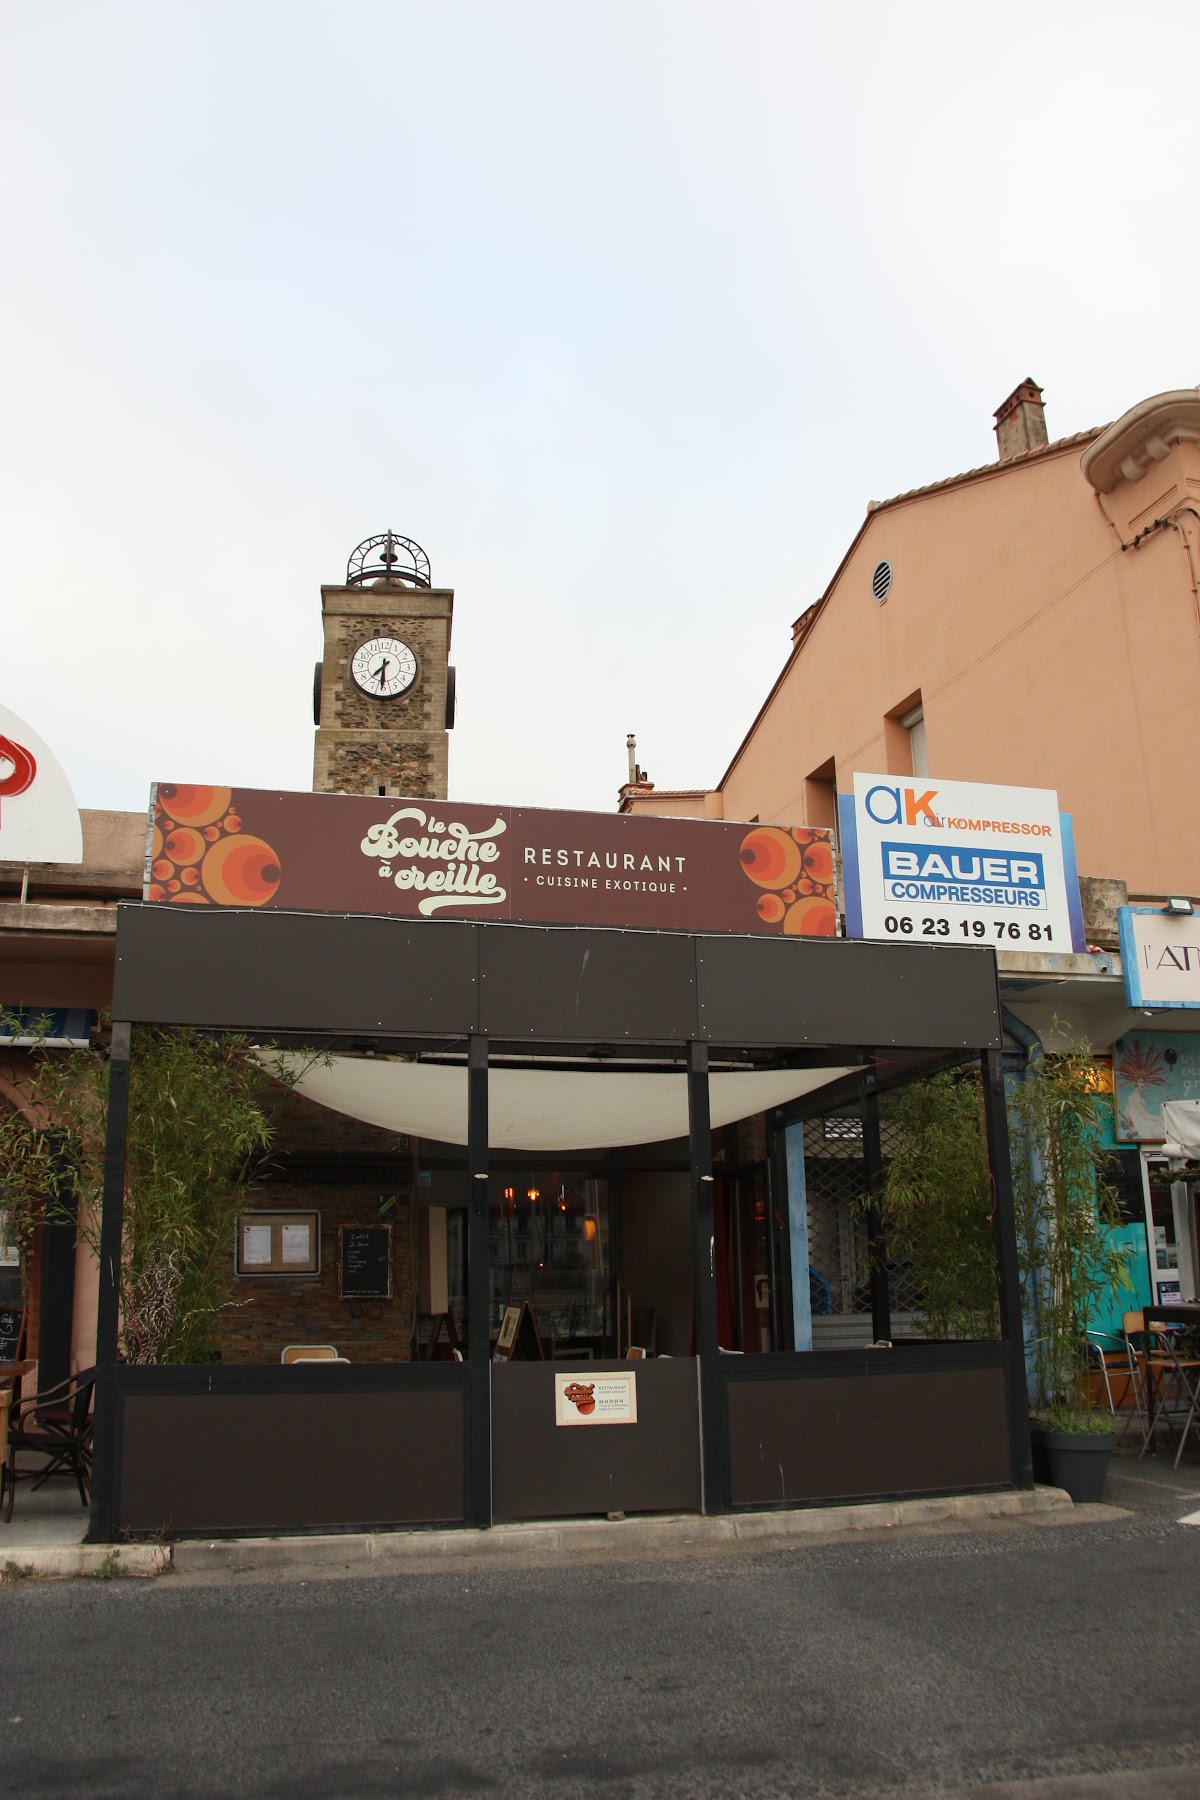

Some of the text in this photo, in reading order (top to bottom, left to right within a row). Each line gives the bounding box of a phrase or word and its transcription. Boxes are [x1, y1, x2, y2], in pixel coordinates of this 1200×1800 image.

[402, 652, 408, 660] 2
[360, 807, 507, 863] Bouche
[428, 816, 446, 834] le
[947, 816, 1052, 837] KOMPRESSOR
[524, 847, 687, 873] RESTAURANT
[888, 850, 1039, 885] BAUER
[394, 863, 507, 916] oreille
[536, 875, 677, 894] CUISINE EXOTIQUE
[891, 881, 1041, 907] COMPRESSEURS
[884, 915, 1054, 941] 06 23 19 76 81
[1143, 944, 1200, 971] l'AT
